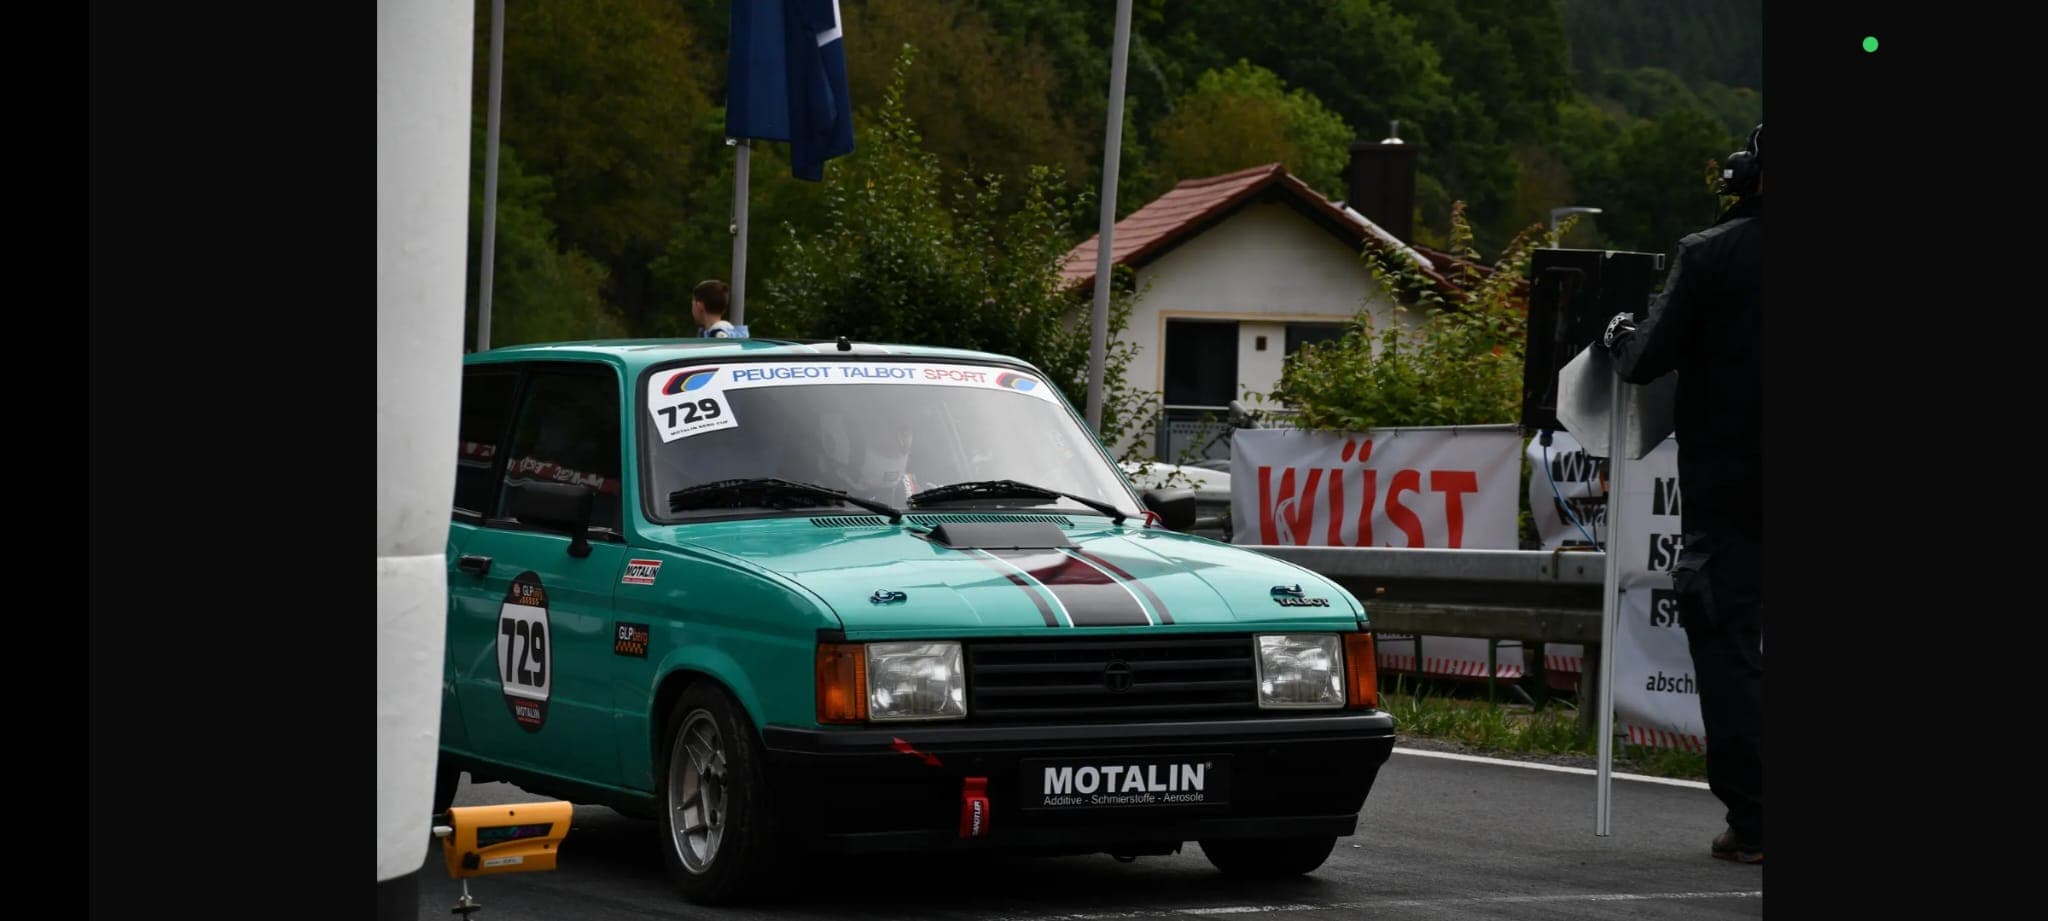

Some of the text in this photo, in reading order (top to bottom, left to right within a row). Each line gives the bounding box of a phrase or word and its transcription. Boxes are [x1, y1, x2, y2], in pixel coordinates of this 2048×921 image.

[732, 366, 987, 383] PEUGEOT TALBOT SPORT
[657, 397, 721, 429] 729
[1258, 439, 1478, 549] WÜST
[1659, 477, 1683, 516] W
[1653, 533, 1685, 572] St
[625, 564, 659, 578] MOTALIN
[1273, 598, 1330, 608] TALBOT
[1655, 597, 1680, 627] Si
[501, 617, 546, 688] 729
[1646, 670, 1698, 695] absch
[1043, 795, 1083, 806] Additive
[1091, 793, 1156, 805] Schmierstoffe
[1163, 791, 1205, 803] Aerosole
